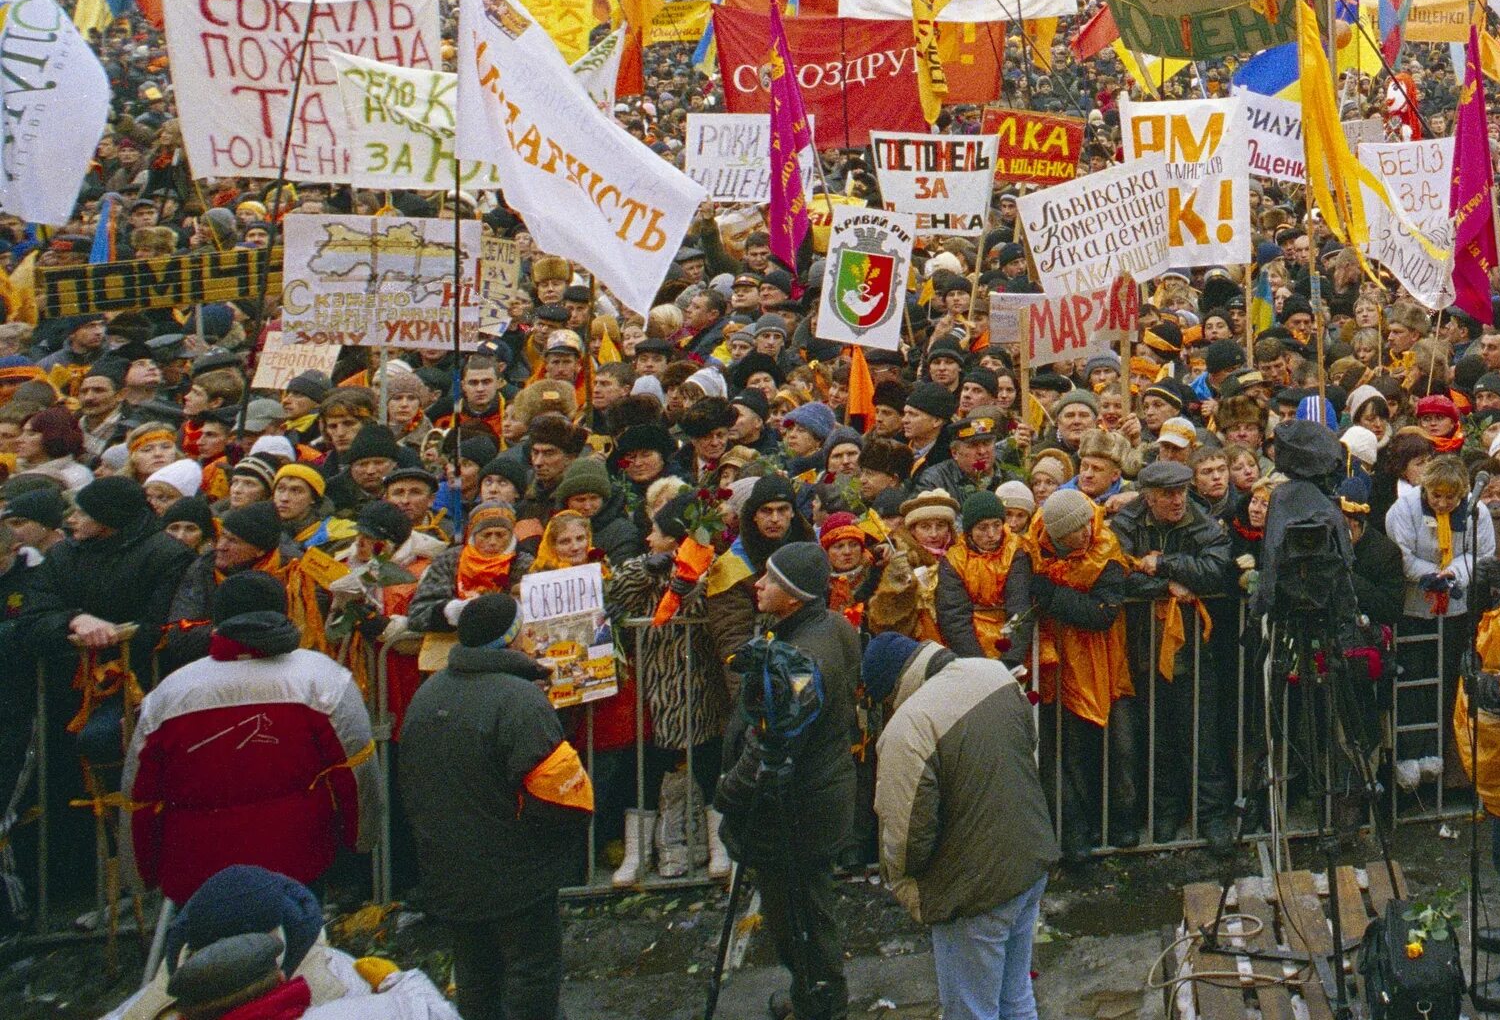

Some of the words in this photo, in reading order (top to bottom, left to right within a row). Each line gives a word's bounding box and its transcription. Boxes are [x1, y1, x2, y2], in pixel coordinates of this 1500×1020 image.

[734, 46, 921, 94] СЮЗДРУ
[997, 117, 1071, 158] ЛКА
[366, 141, 413, 174] ЗА
[875, 138, 990, 172] ГОСТОМЕЛЬ
[1009, 158, 1077, 178] ЮЩЕНКА
[1377, 143, 1443, 175] БЕЛЗ
[914, 176, 949, 199] ЗА
[834, 214, 889, 235] КРИВИЙ
[891, 224, 913, 244] РІГ
[529, 578, 600, 620] СКВИРА
